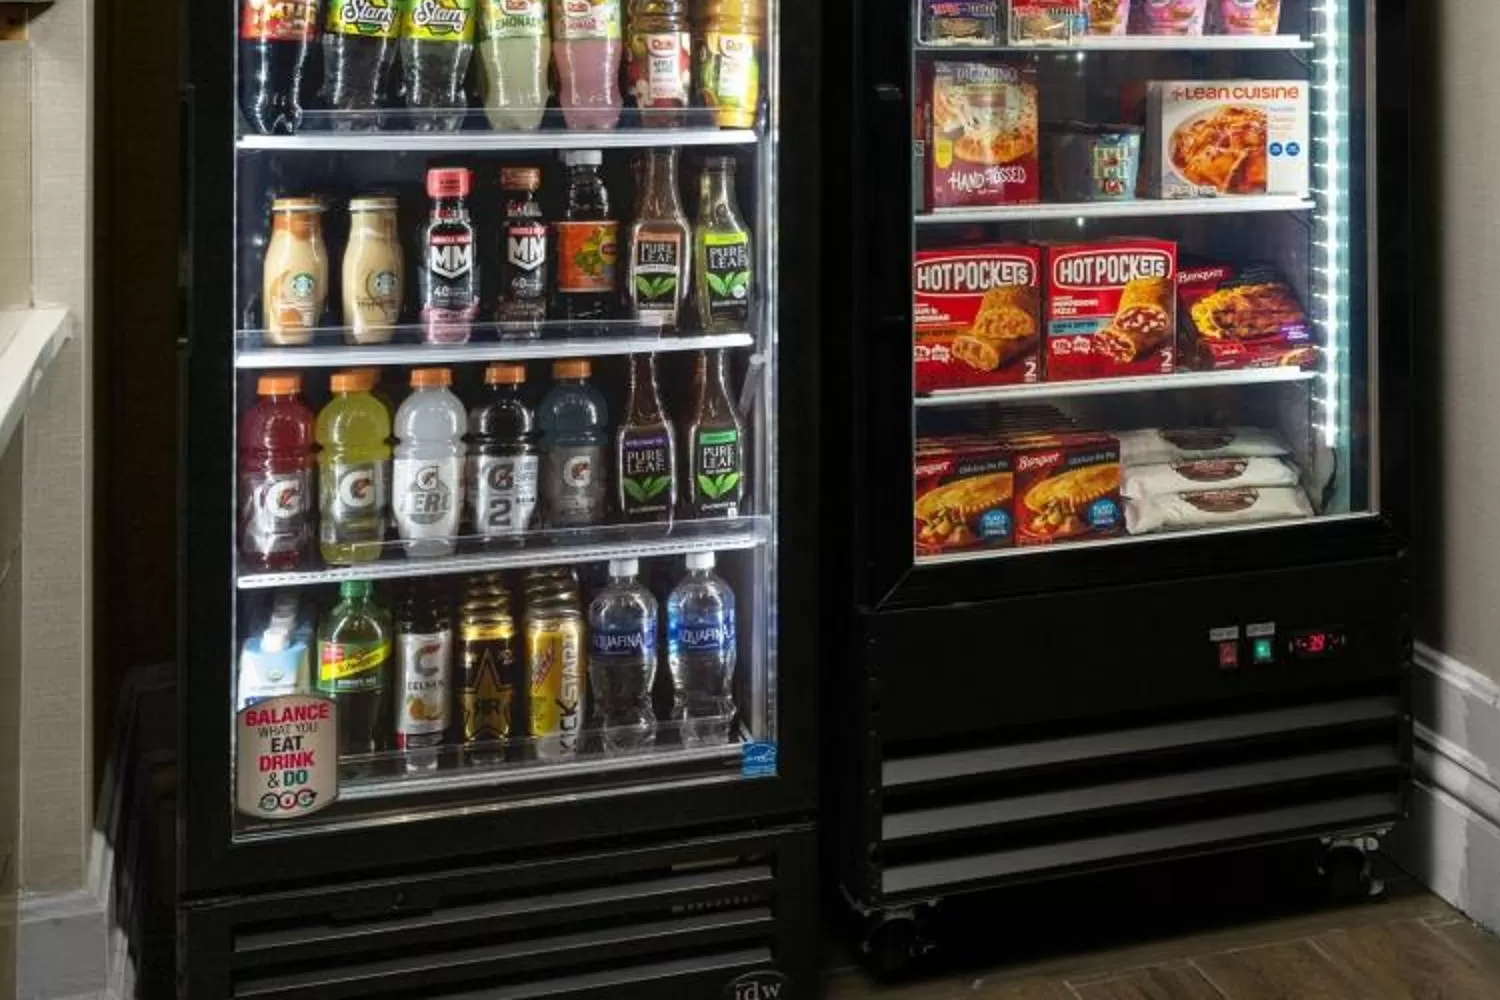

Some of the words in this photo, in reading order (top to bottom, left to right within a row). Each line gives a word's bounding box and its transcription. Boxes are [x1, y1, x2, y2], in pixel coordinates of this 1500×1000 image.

[917, 263, 954, 291] HOT
[953, 260, 1029, 291] POCKETS
[1060, 257, 1094, 284] HOT
[1095, 255, 1166, 283] POCKETS
[1024, 361, 1038, 377] 2
[1161, 352, 1173, 367] 2
[703, 446, 735, 459] PURE
[703, 456, 735, 470] LEAF
[489, 500, 513, 528] 2
[246, 704, 330, 727] BALANCE
[294, 722, 318, 734] YOU
[259, 752, 315, 772] DRINK
[268, 773, 280, 789] &
[283, 770, 308, 786] DO
